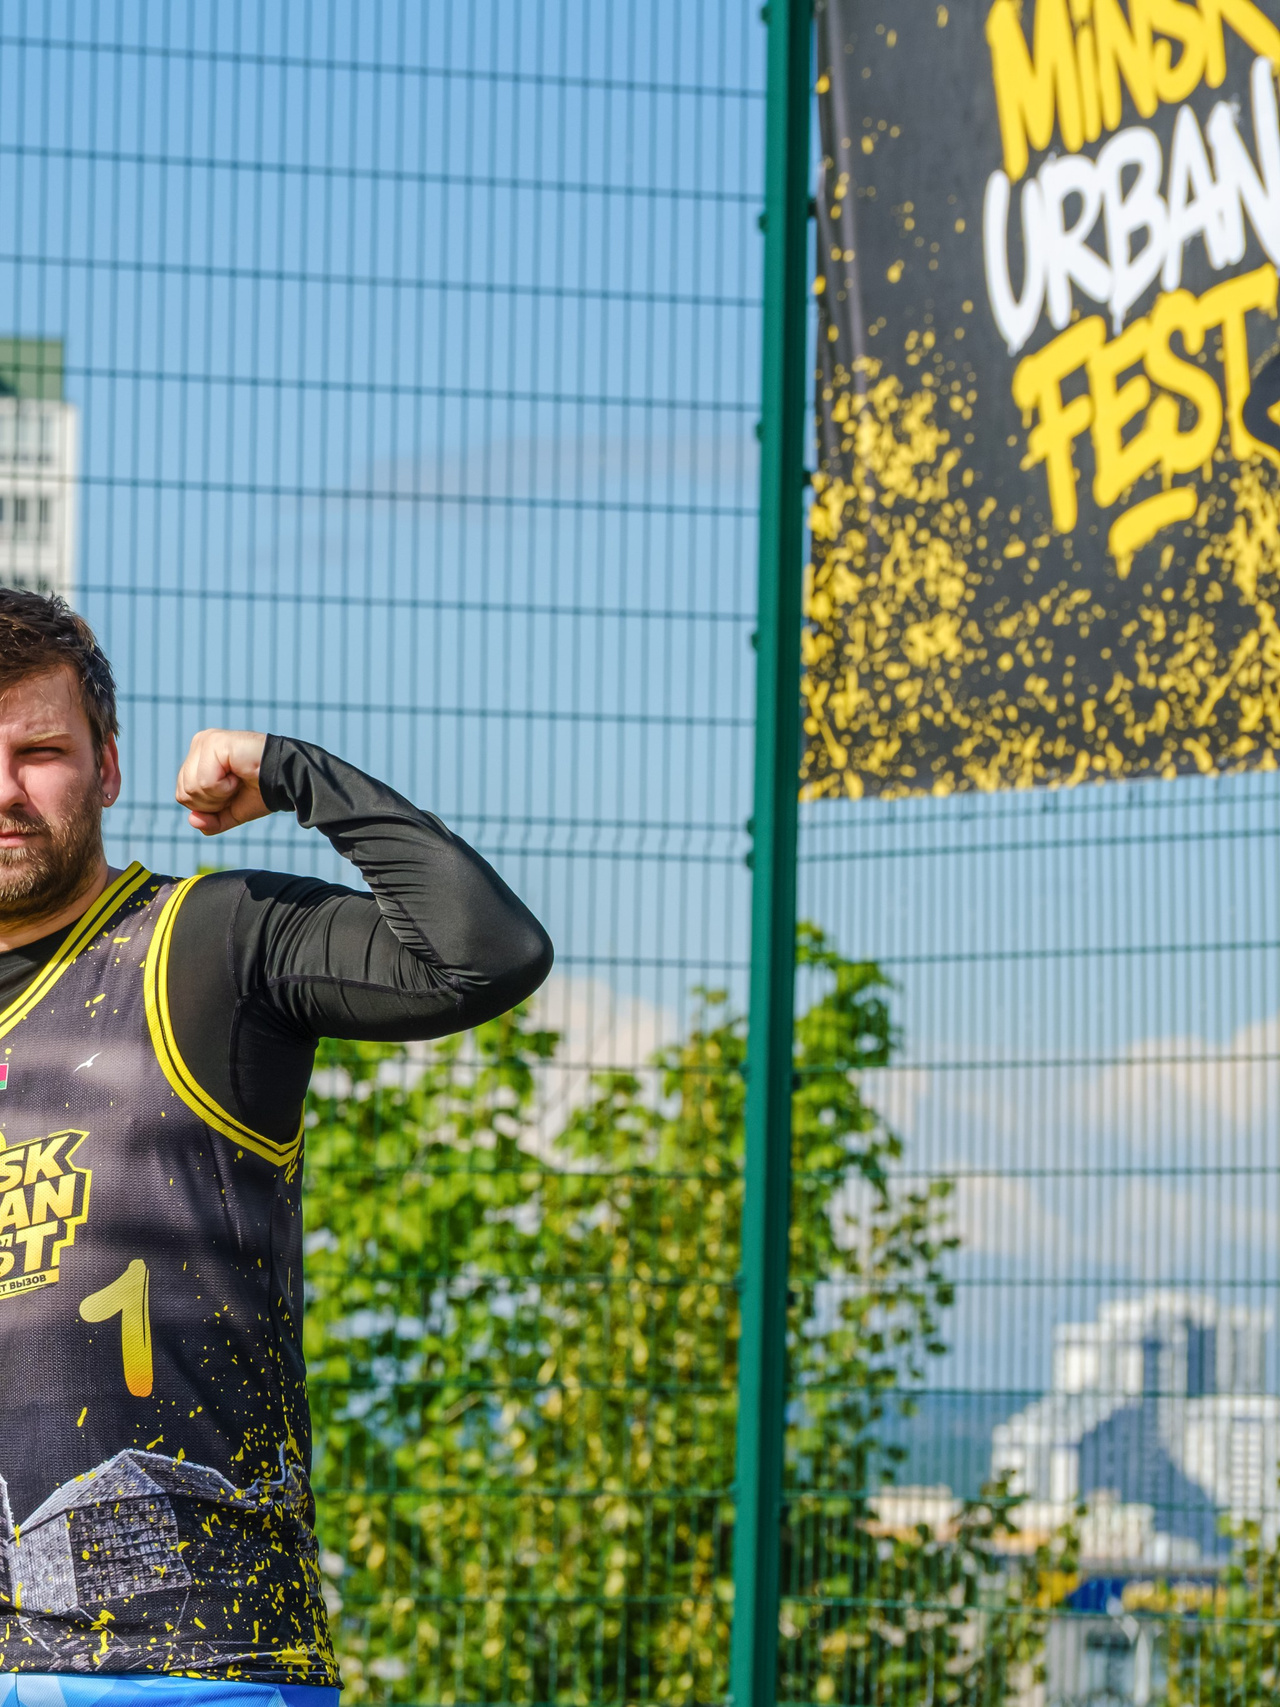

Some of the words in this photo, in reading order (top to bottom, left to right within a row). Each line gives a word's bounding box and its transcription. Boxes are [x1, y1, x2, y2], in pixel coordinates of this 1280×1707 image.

[984, 56, 1280, 354] URBAN
[1013, 262, 1280, 534] FEST
[9, 1272, 48, 1294] ВЫЗОВ
[79, 1258, 154, 1398] 1
